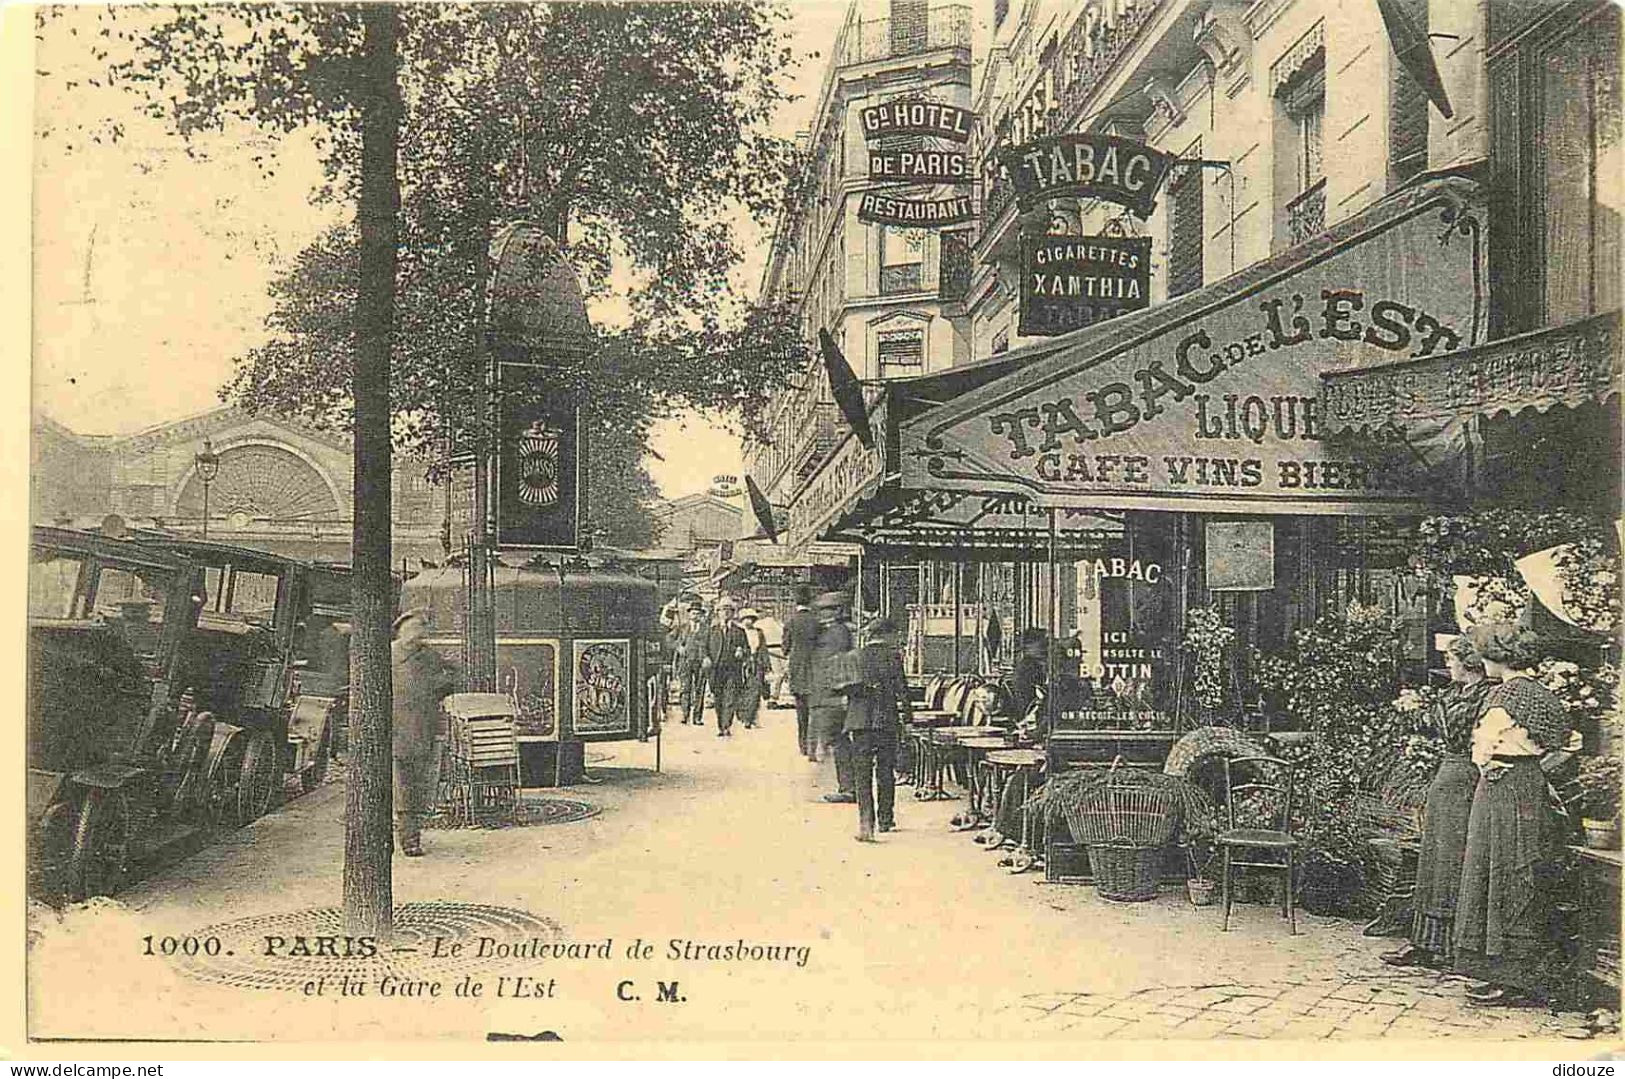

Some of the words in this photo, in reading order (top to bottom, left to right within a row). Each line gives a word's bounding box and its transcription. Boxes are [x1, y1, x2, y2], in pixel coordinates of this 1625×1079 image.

[894, 104, 968, 134] HOTEL
[871, 155, 894, 175] DE
[900, 154, 966, 176] PARIS
[1023, 143, 1150, 191] TABAC
[863, 195, 969, 220] RESTAURANT
[1036, 246, 1139, 269] CIGARETTES
[1033, 273, 1141, 299] XANTHIA
[989, 327, 1227, 460] TABAC
[1222, 333, 1266, 366] DE
[1259, 288, 1462, 358] L'EST
[1195, 394, 1326, 444] LIQUE
[1036, 453, 1149, 482] CAFE
[1164, 456, 1263, 489] VINS
[1073, 558, 1161, 584] TABAC
[1104, 632, 1127, 644] ICI
[1079, 663, 1152, 679] BOTTIN
